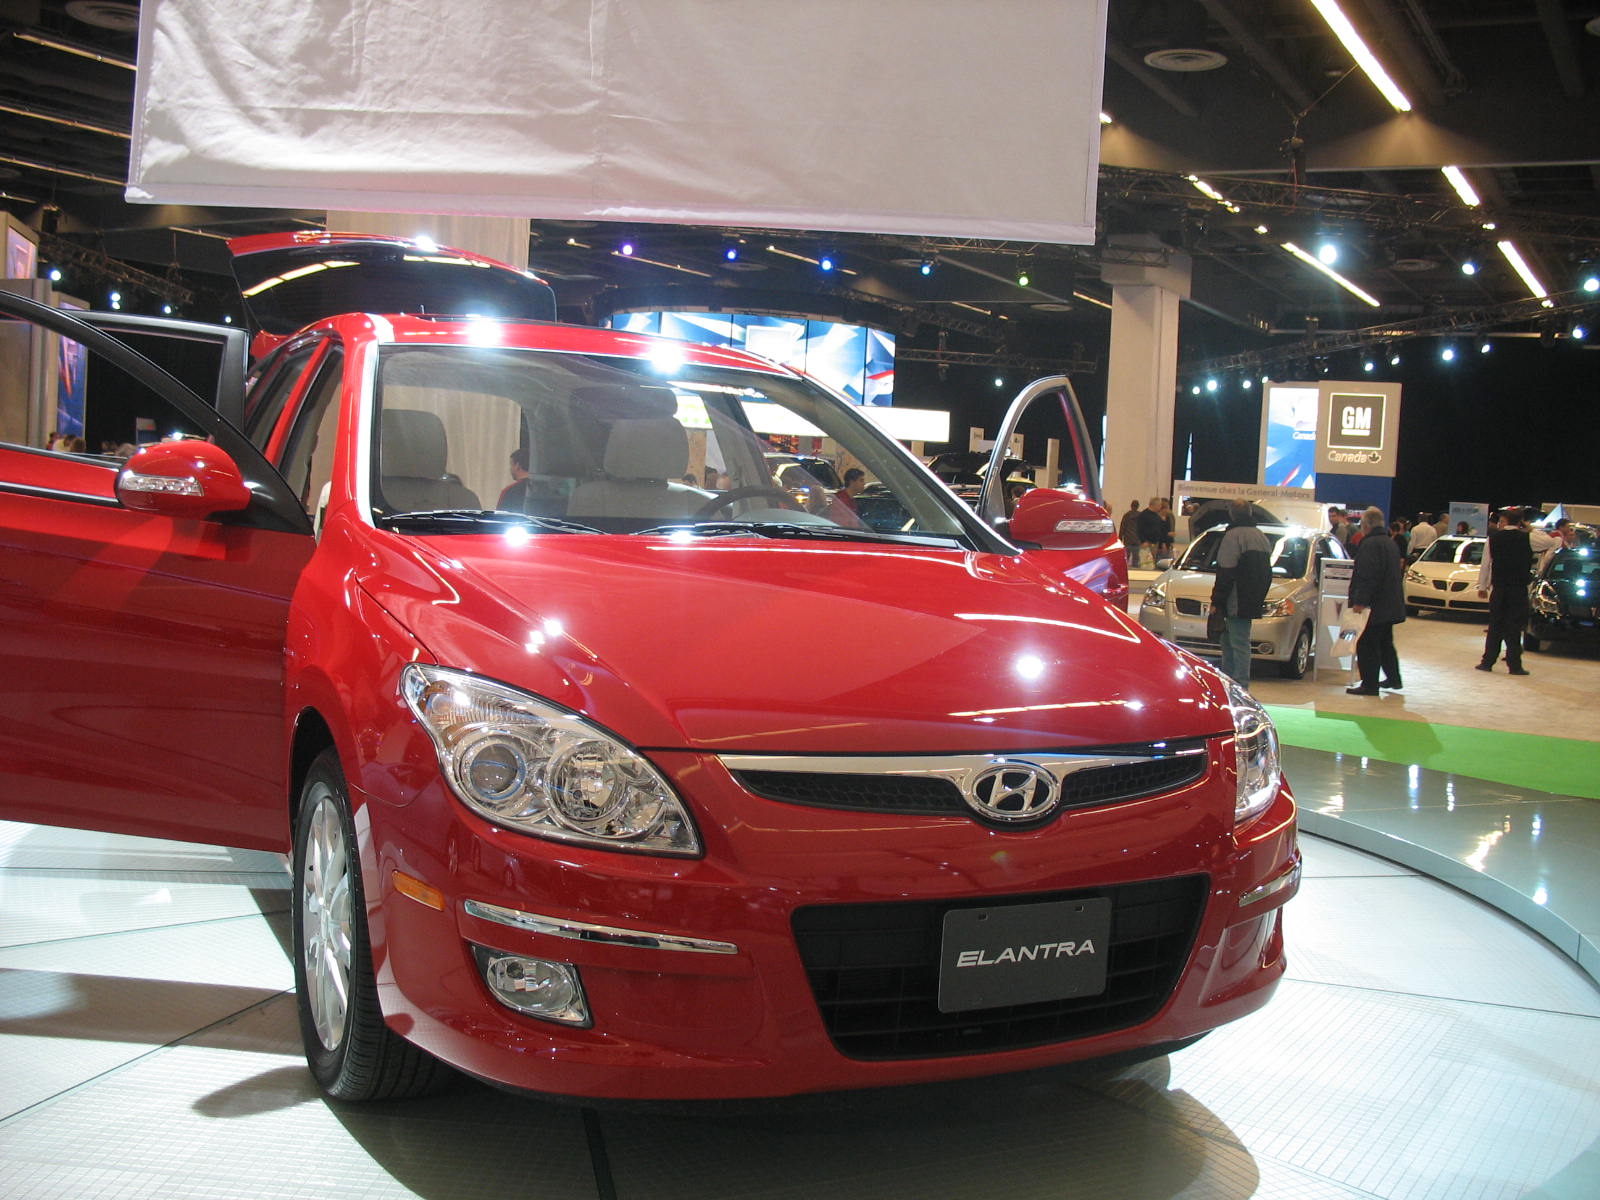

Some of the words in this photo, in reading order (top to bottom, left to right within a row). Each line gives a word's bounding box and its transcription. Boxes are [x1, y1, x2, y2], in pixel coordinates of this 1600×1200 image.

[1342, 406, 1372, 430] GM
[1328, 450, 1368, 464] Canada
[1178, 483, 1218, 494] Bienvenue
[1219, 485, 1236, 495] chez
[1238, 486, 1245, 495] la
[1247, 487, 1278, 497] General
[1280, 489, 1310, 499] Motors
[956, 939, 1096, 968] ELANTRA
